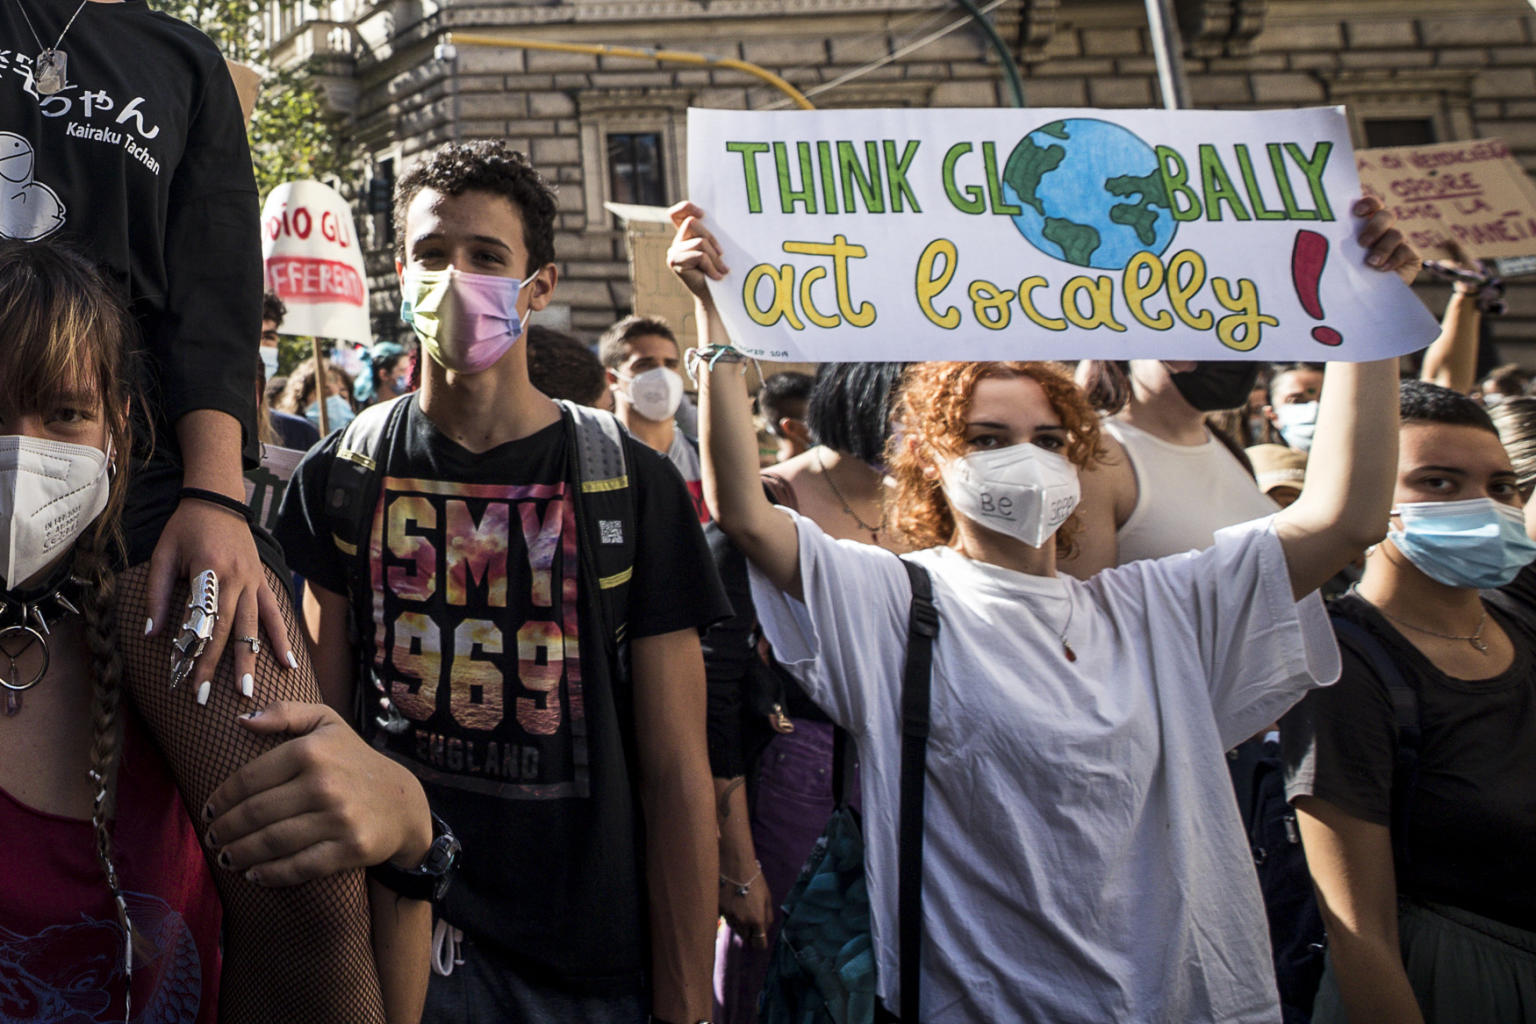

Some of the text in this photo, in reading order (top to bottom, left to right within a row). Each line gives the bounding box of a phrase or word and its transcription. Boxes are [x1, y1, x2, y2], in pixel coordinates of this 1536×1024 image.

[66, 122, 161, 176] Kairaku Tachan
[726, 139, 922, 216] THINK
[742, 235, 875, 331] act
[387, 495, 565, 608] SMY
